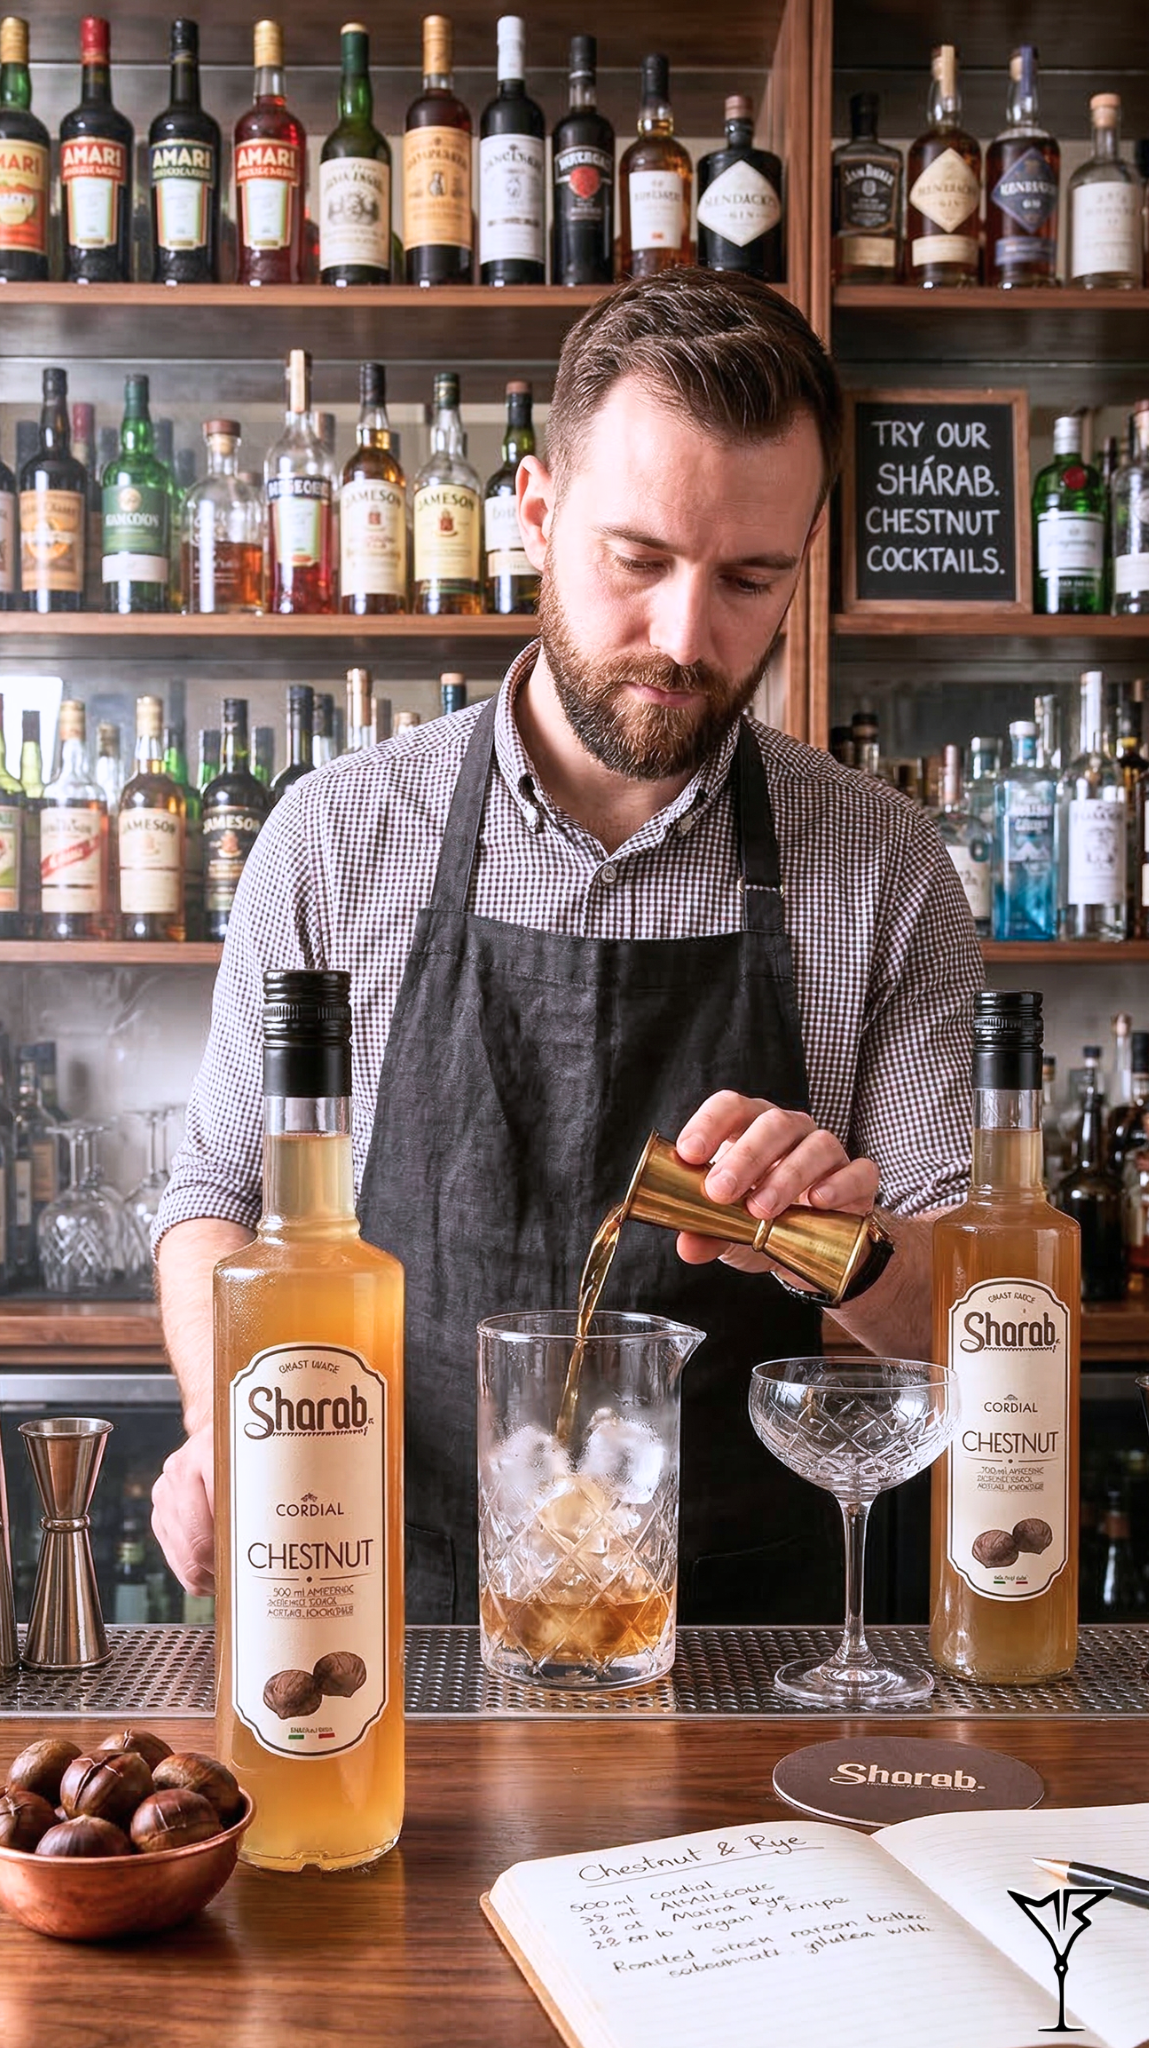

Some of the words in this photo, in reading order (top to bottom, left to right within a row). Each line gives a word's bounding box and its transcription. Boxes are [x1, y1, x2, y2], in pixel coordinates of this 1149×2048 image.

[63, 146, 122, 167] AMARI
[152, 147, 211, 169] AMARI
[237, 147, 295, 169] AMARI
[871, 421, 924, 447] TRY
[936, 422, 991, 449] OUR
[345, 489, 401, 509] JAMESON
[417, 493, 475, 512] JAMESON
[866, 506, 1000, 535] CHESTNUT
[867, 545, 1005, 575] COCKTAILS.
[123, 819, 177, 836] JAMESON
[983, 1401, 1038, 1413] CORDIAL
[962, 1431, 1059, 1454] CHESTNUT
[276, 1502, 345, 1517] CORDIAL
[247, 1539, 374, 1570] CHESTNUT
[578, 1848, 703, 1882] Chestnut
[717, 1841, 735, 1856] &
[745, 1834, 808, 1855] Rye
[649, 1880, 716, 1900] cordial
[748, 1894, 791, 1908] Rye
[691, 1914, 754, 1932] vegan
